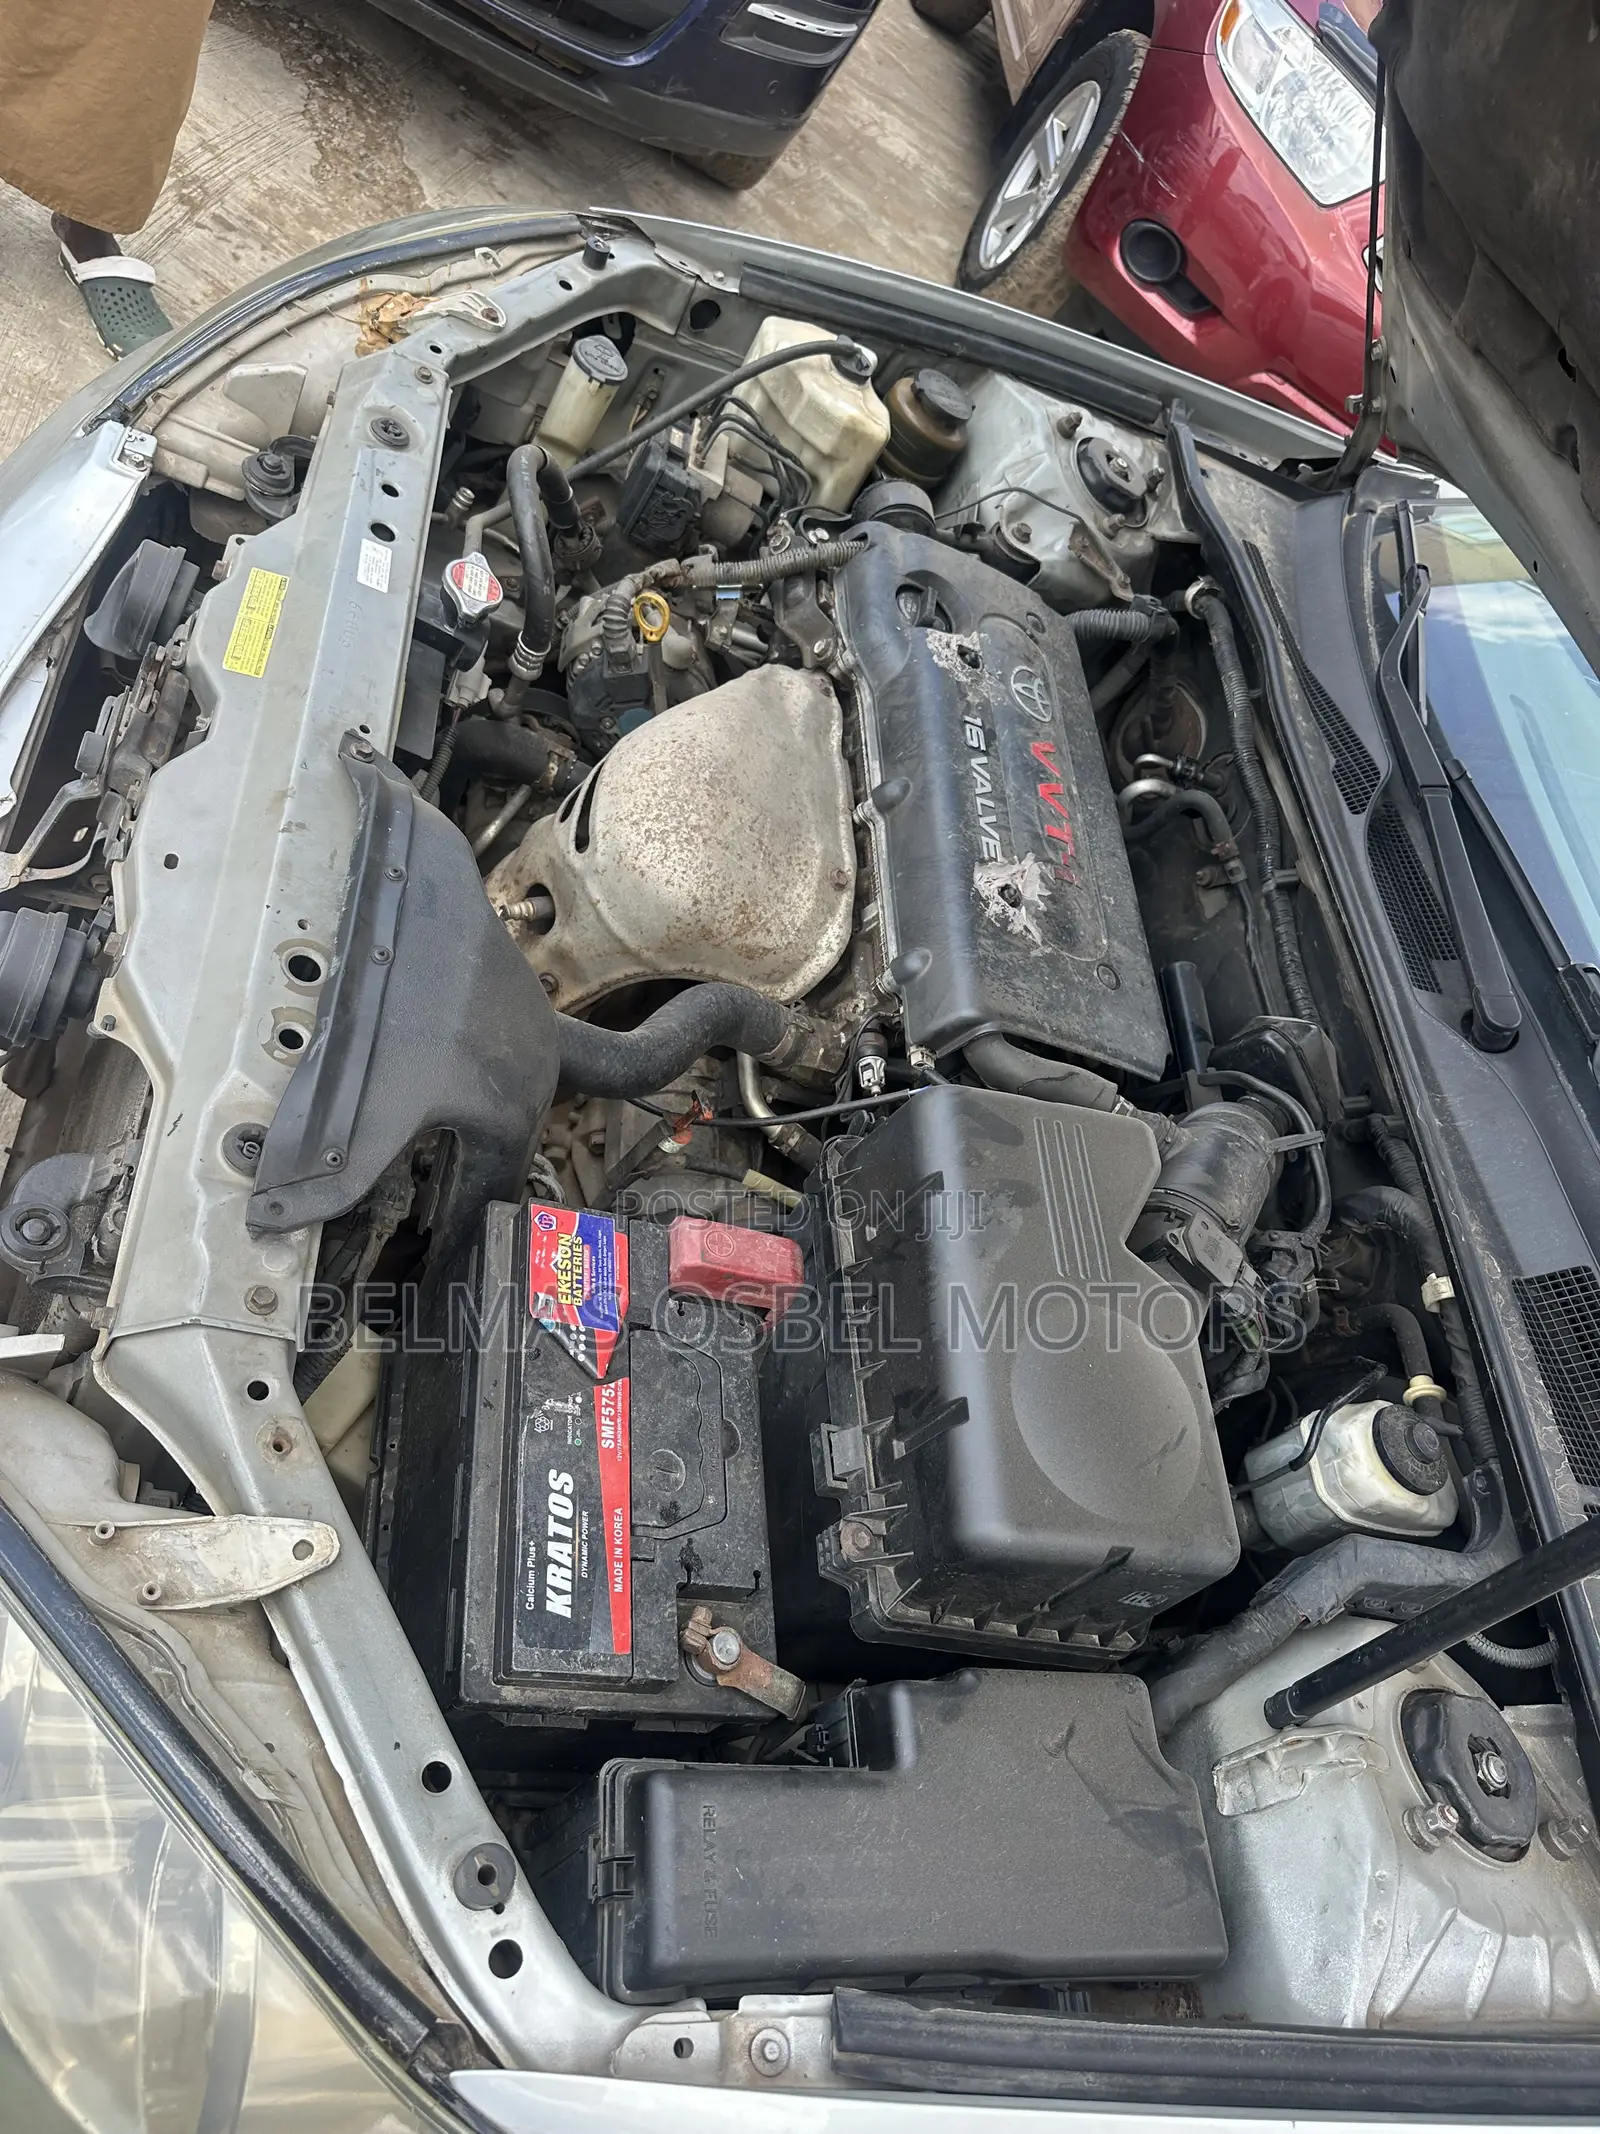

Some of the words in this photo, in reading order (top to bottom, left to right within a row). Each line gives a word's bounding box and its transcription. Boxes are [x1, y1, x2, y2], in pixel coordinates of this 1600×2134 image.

[963, 714, 987, 753] 16
[970, 755, 1003, 862] VALVE
[557, 1232, 572, 1304] EKESON
[573, 1236, 583, 1306] BATTERIES
[546, 1469, 574, 1618] KRATOS
[581, 1510, 589, 1544] POWER
[613, 1507, 624, 1545] KOREA
[526, 1540, 537, 1567] Plus+
[580, 1545, 589, 1579] DYNAMIC
[613, 1547, 623, 1557] IN
[525, 1568, 537, 1611] Calcium
[613, 1560, 624, 1593] MADE
[703, 1805, 717, 1865] RELAY
[703, 1868, 717, 1883] &
[703, 1888, 718, 1940] FUSE
